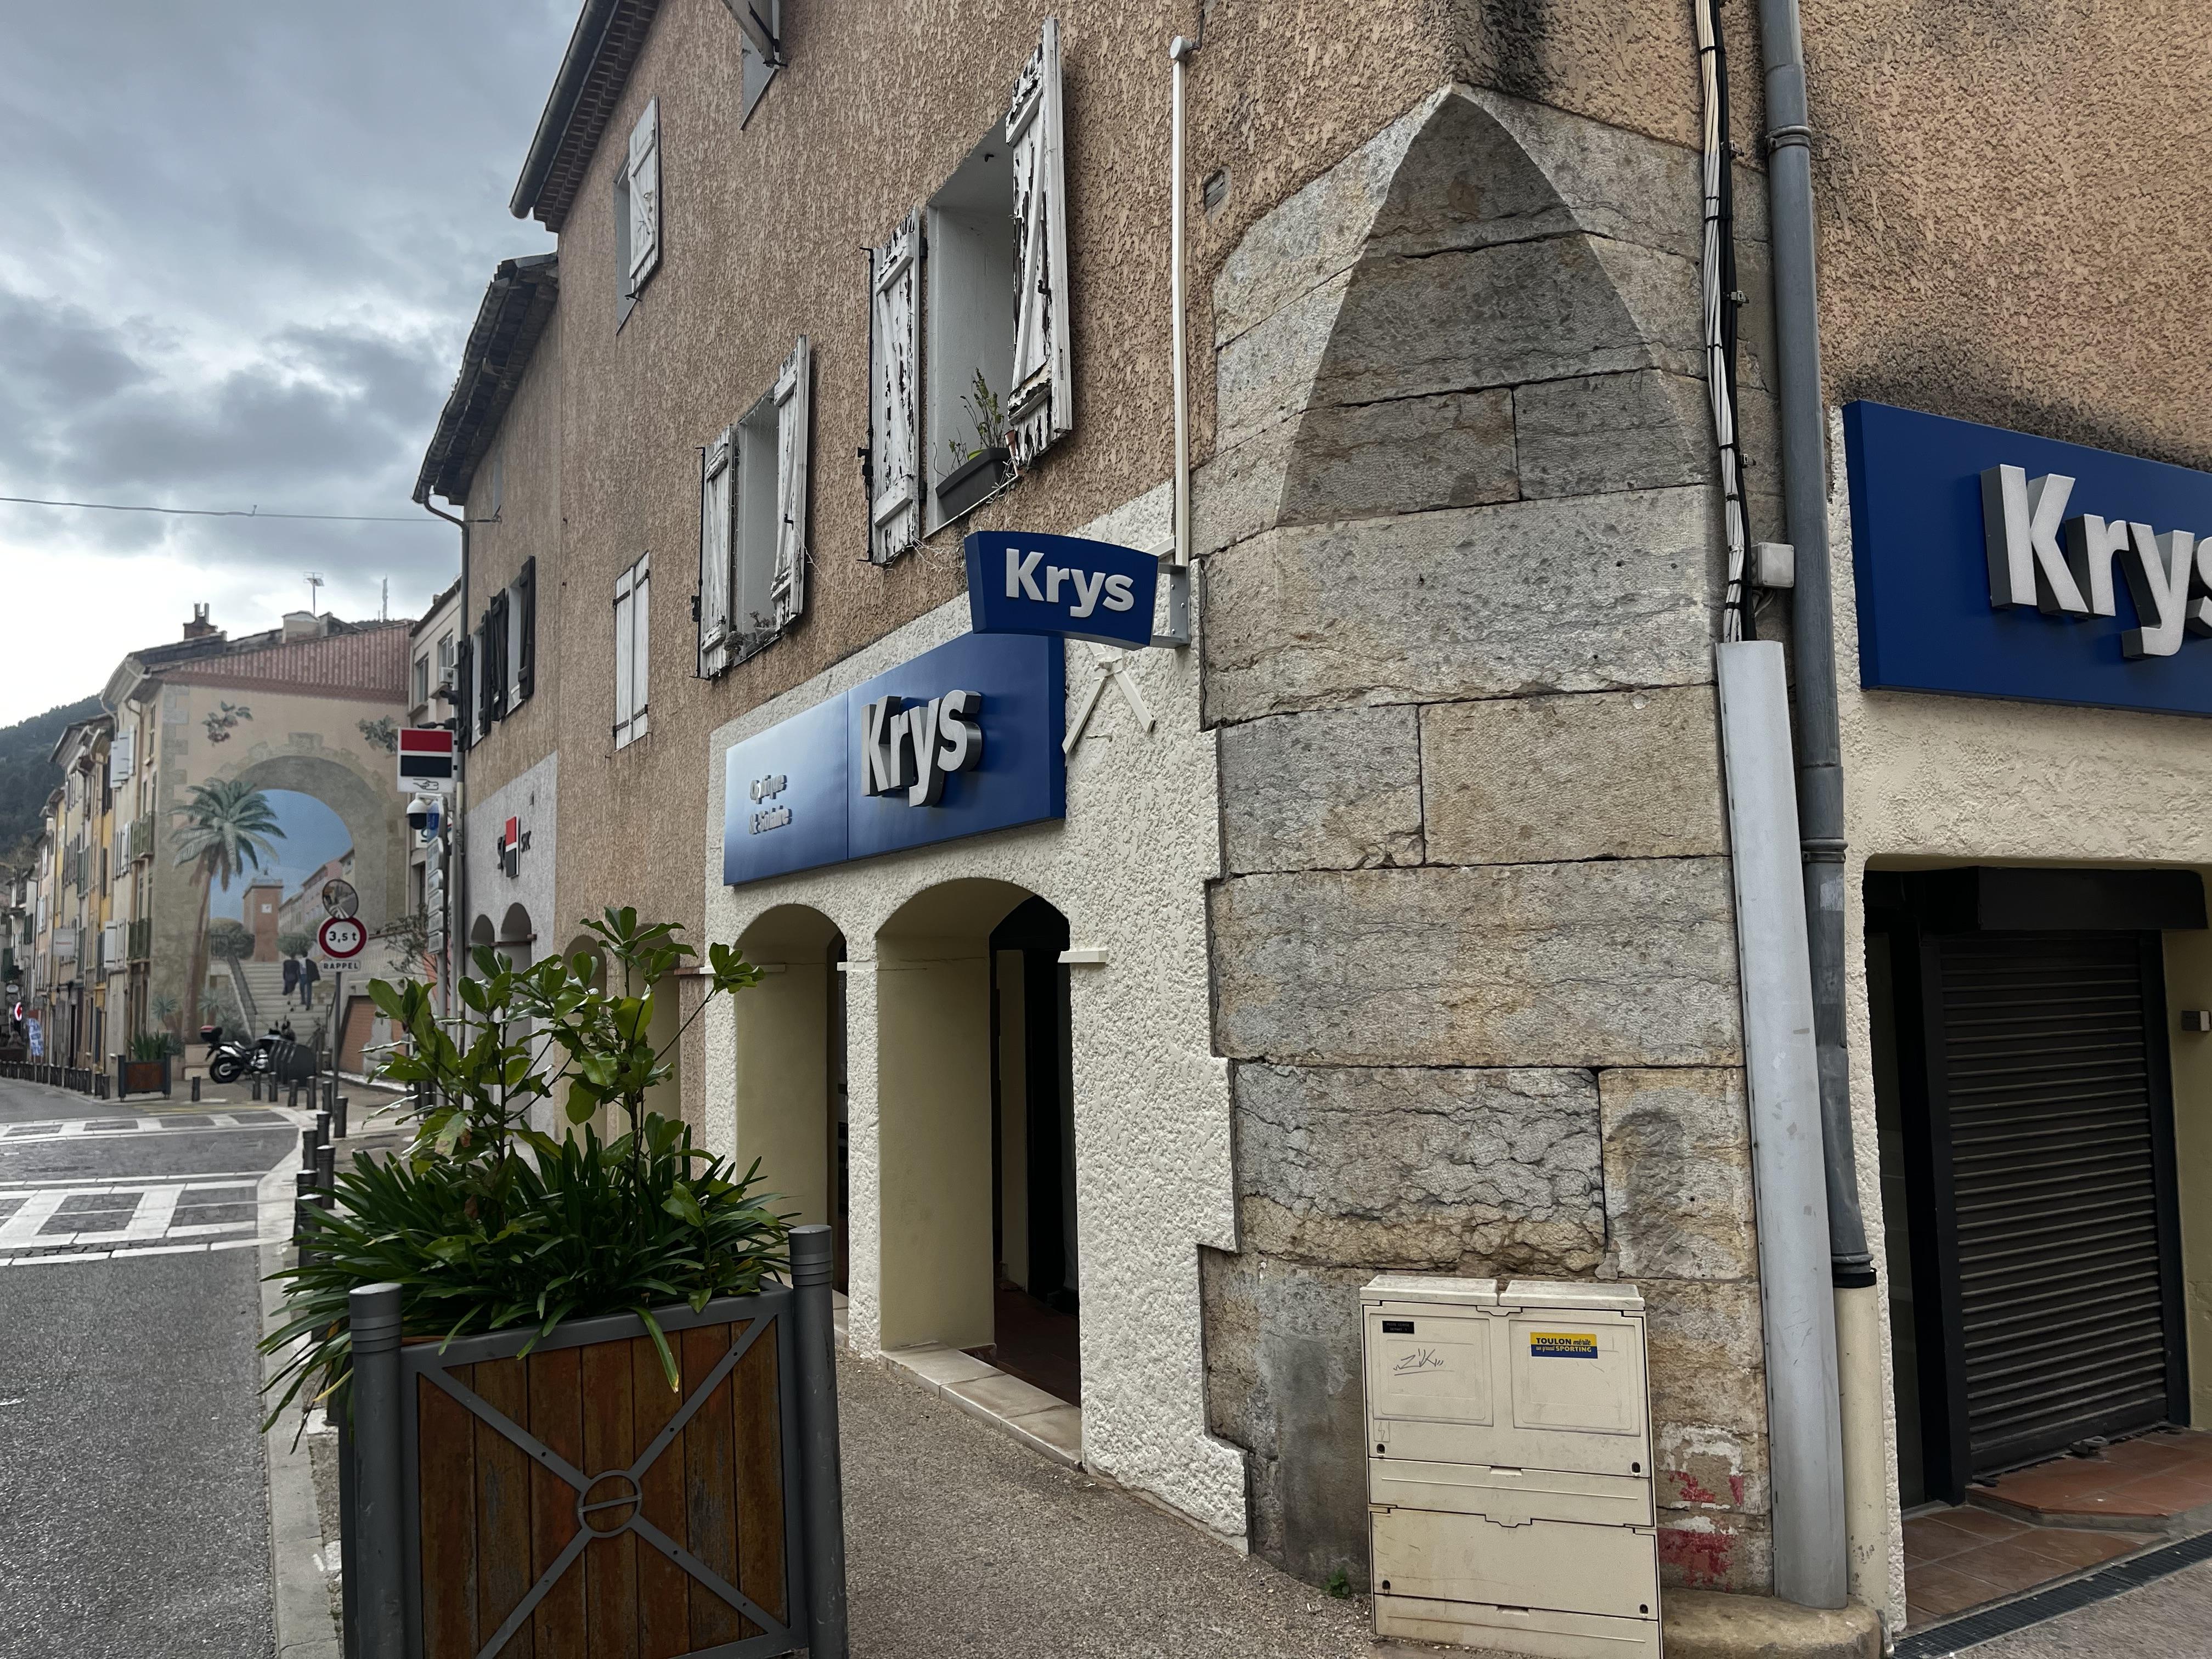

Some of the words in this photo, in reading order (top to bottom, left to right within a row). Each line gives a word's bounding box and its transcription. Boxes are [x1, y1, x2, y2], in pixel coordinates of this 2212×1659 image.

[1005, 548, 1135, 618] Krys
[1981, 464, 2212, 657] Kry
[861, 690, 982, 808] Krys
[329, 931, 348, 943] 3,5
